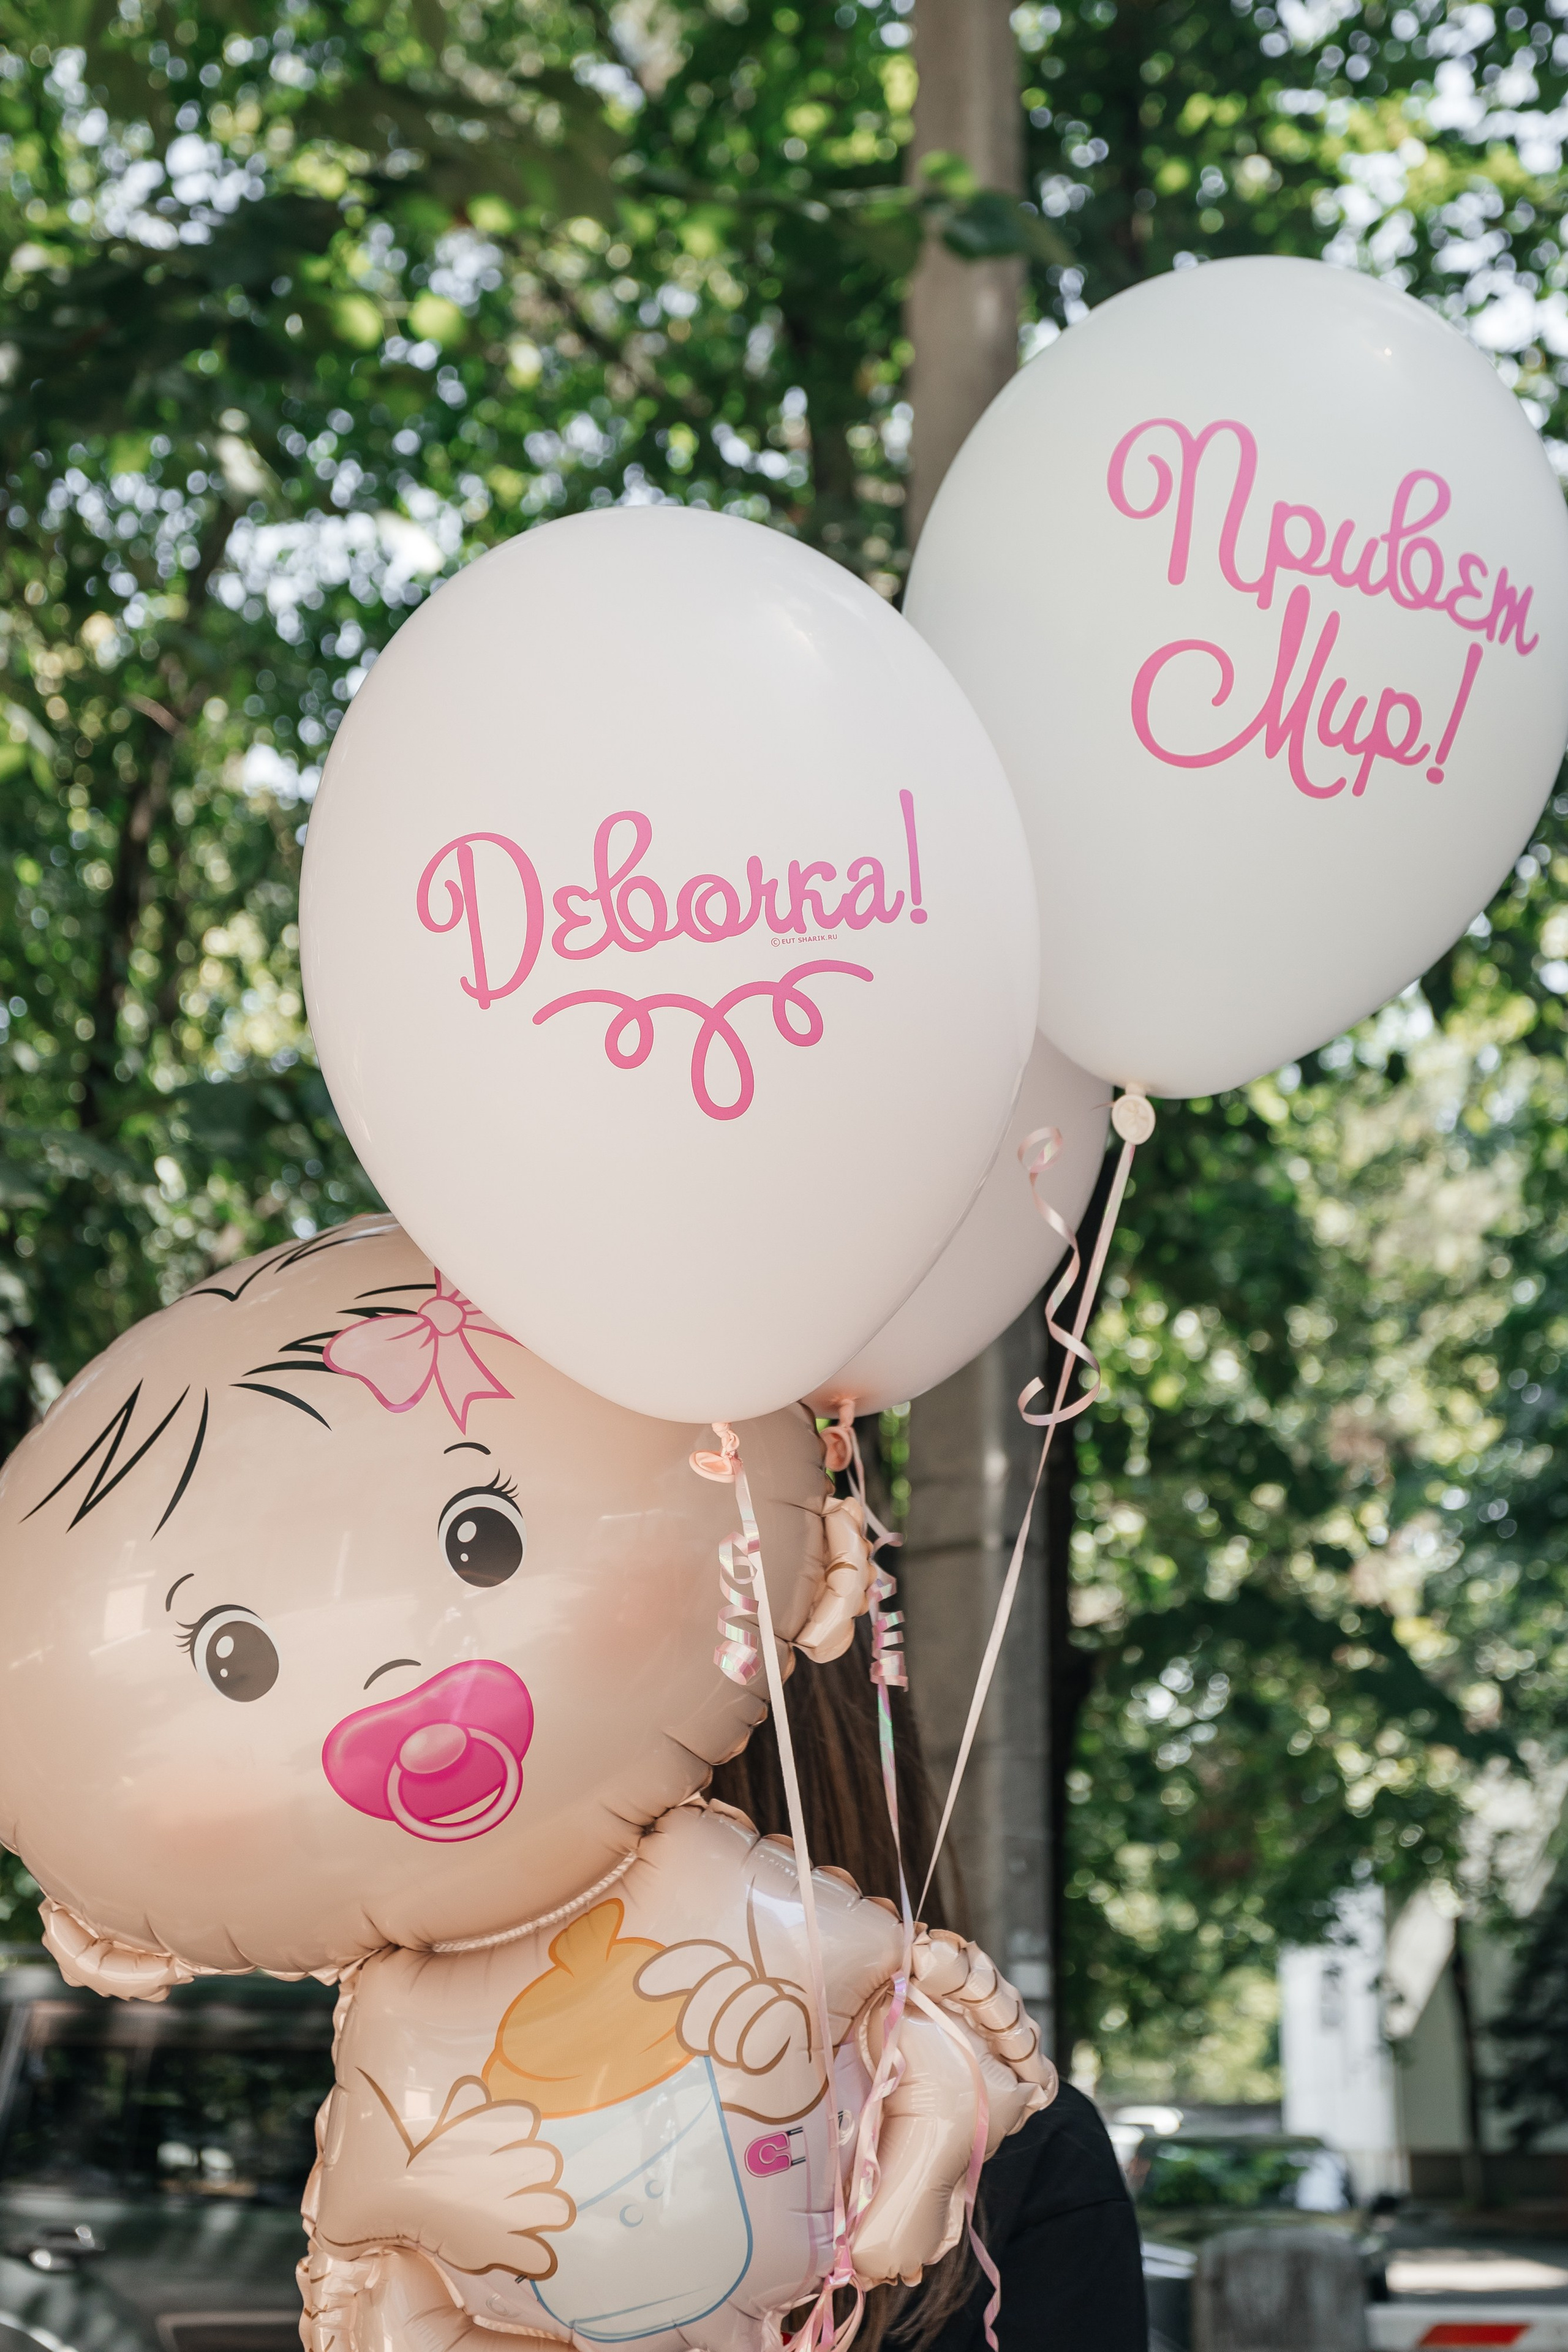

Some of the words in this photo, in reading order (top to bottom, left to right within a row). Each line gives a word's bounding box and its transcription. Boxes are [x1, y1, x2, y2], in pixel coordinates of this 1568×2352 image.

[1106, 418, 1540, 657] Привет
[1131, 584, 1484, 799] Мир!
[416, 788, 929, 1011] Девочка!
[797, 934, 838, 943] SHARIK.RU
